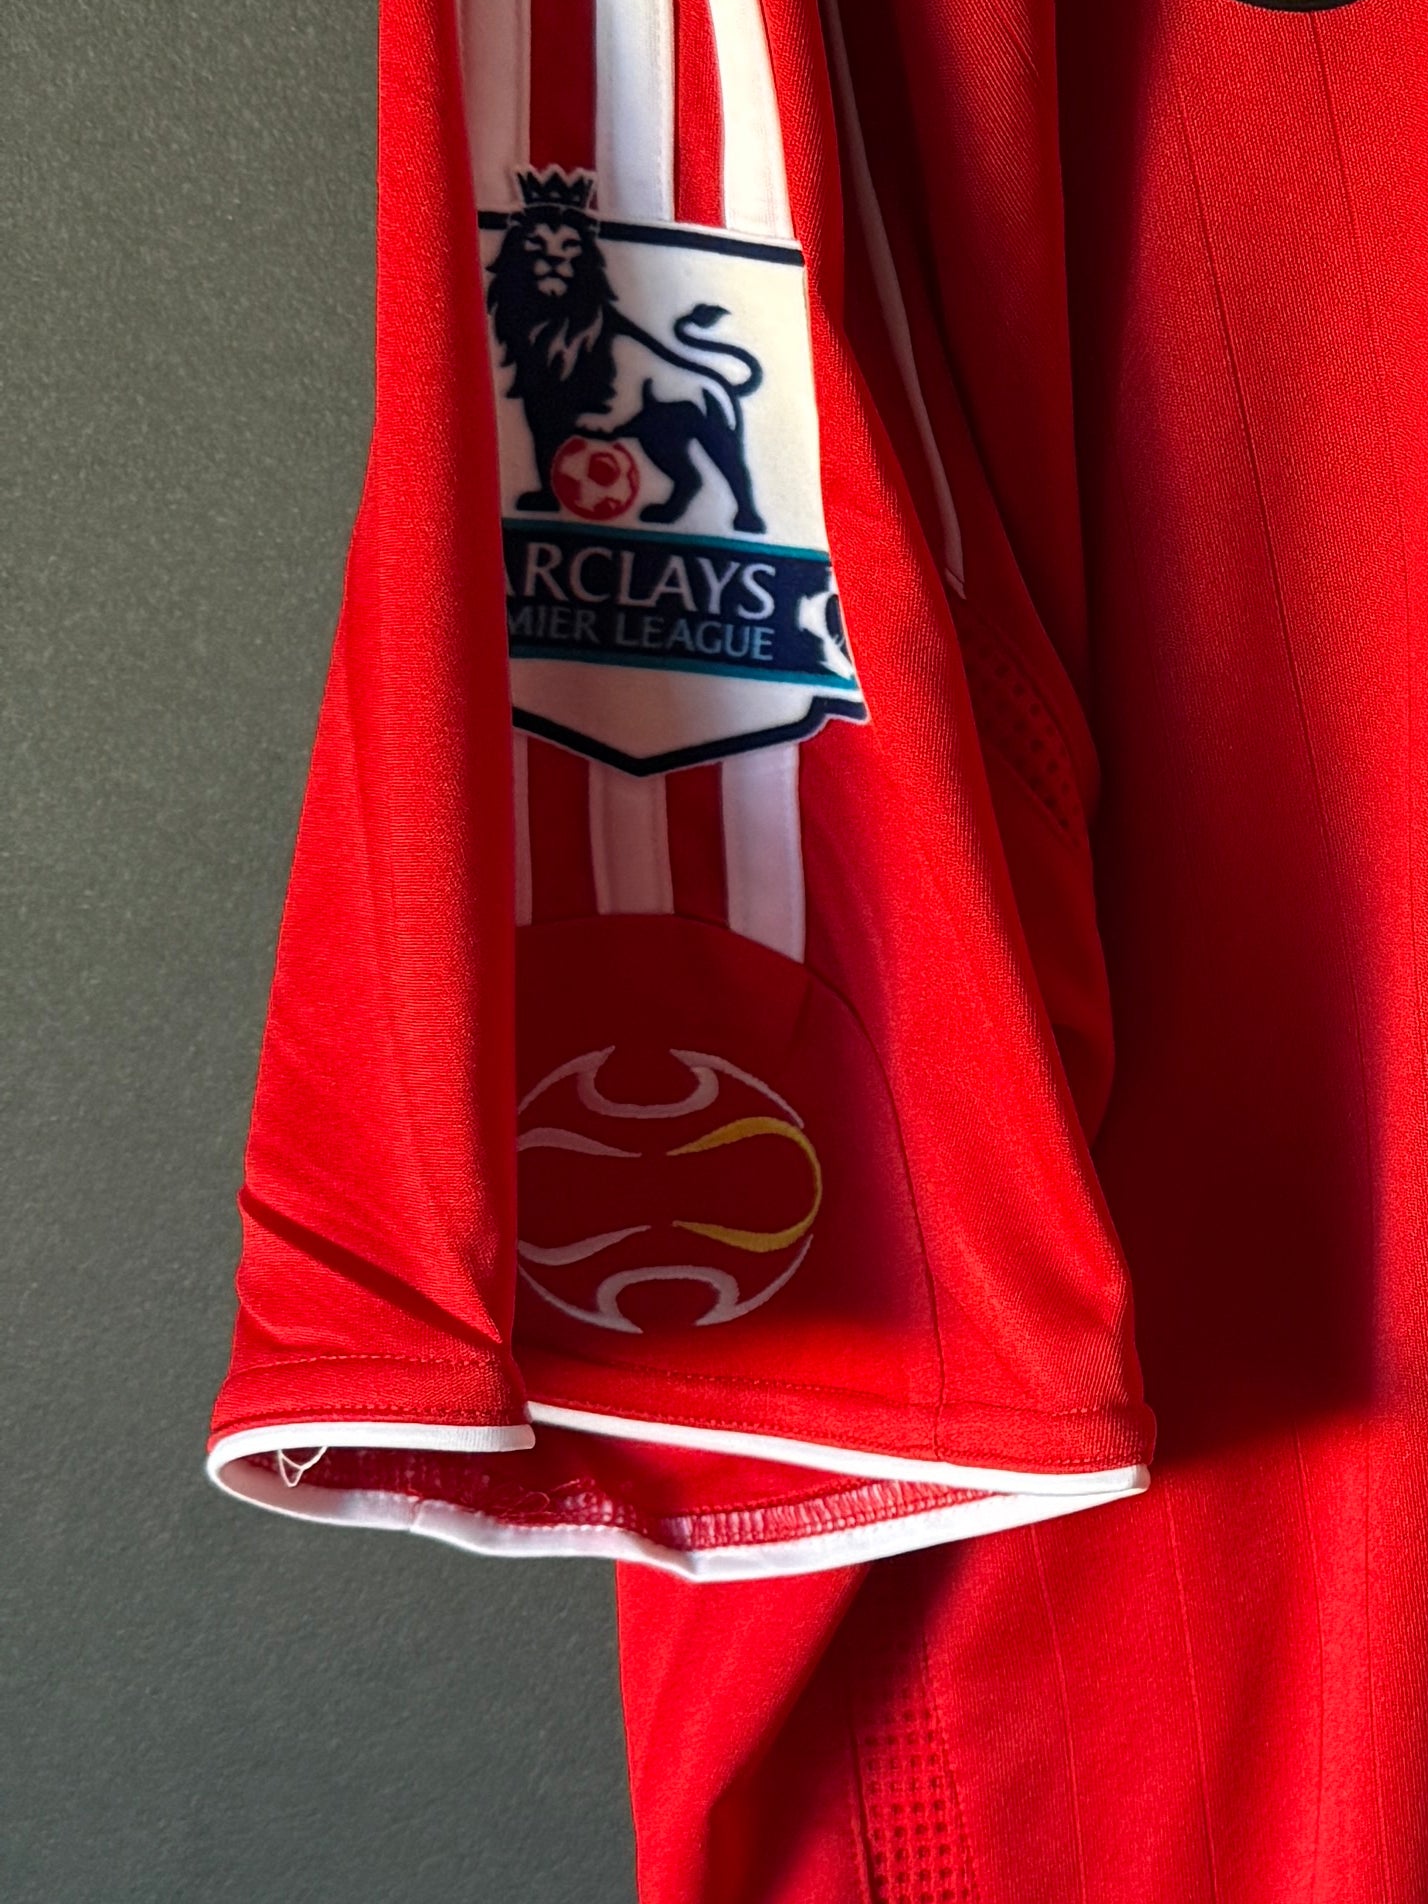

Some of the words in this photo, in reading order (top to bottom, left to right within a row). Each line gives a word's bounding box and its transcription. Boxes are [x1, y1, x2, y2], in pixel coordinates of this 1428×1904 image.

[504, 542, 776, 621] RCLAYS
[508, 604, 601, 645] MIER
[613, 609, 776, 662] LEAGUE
